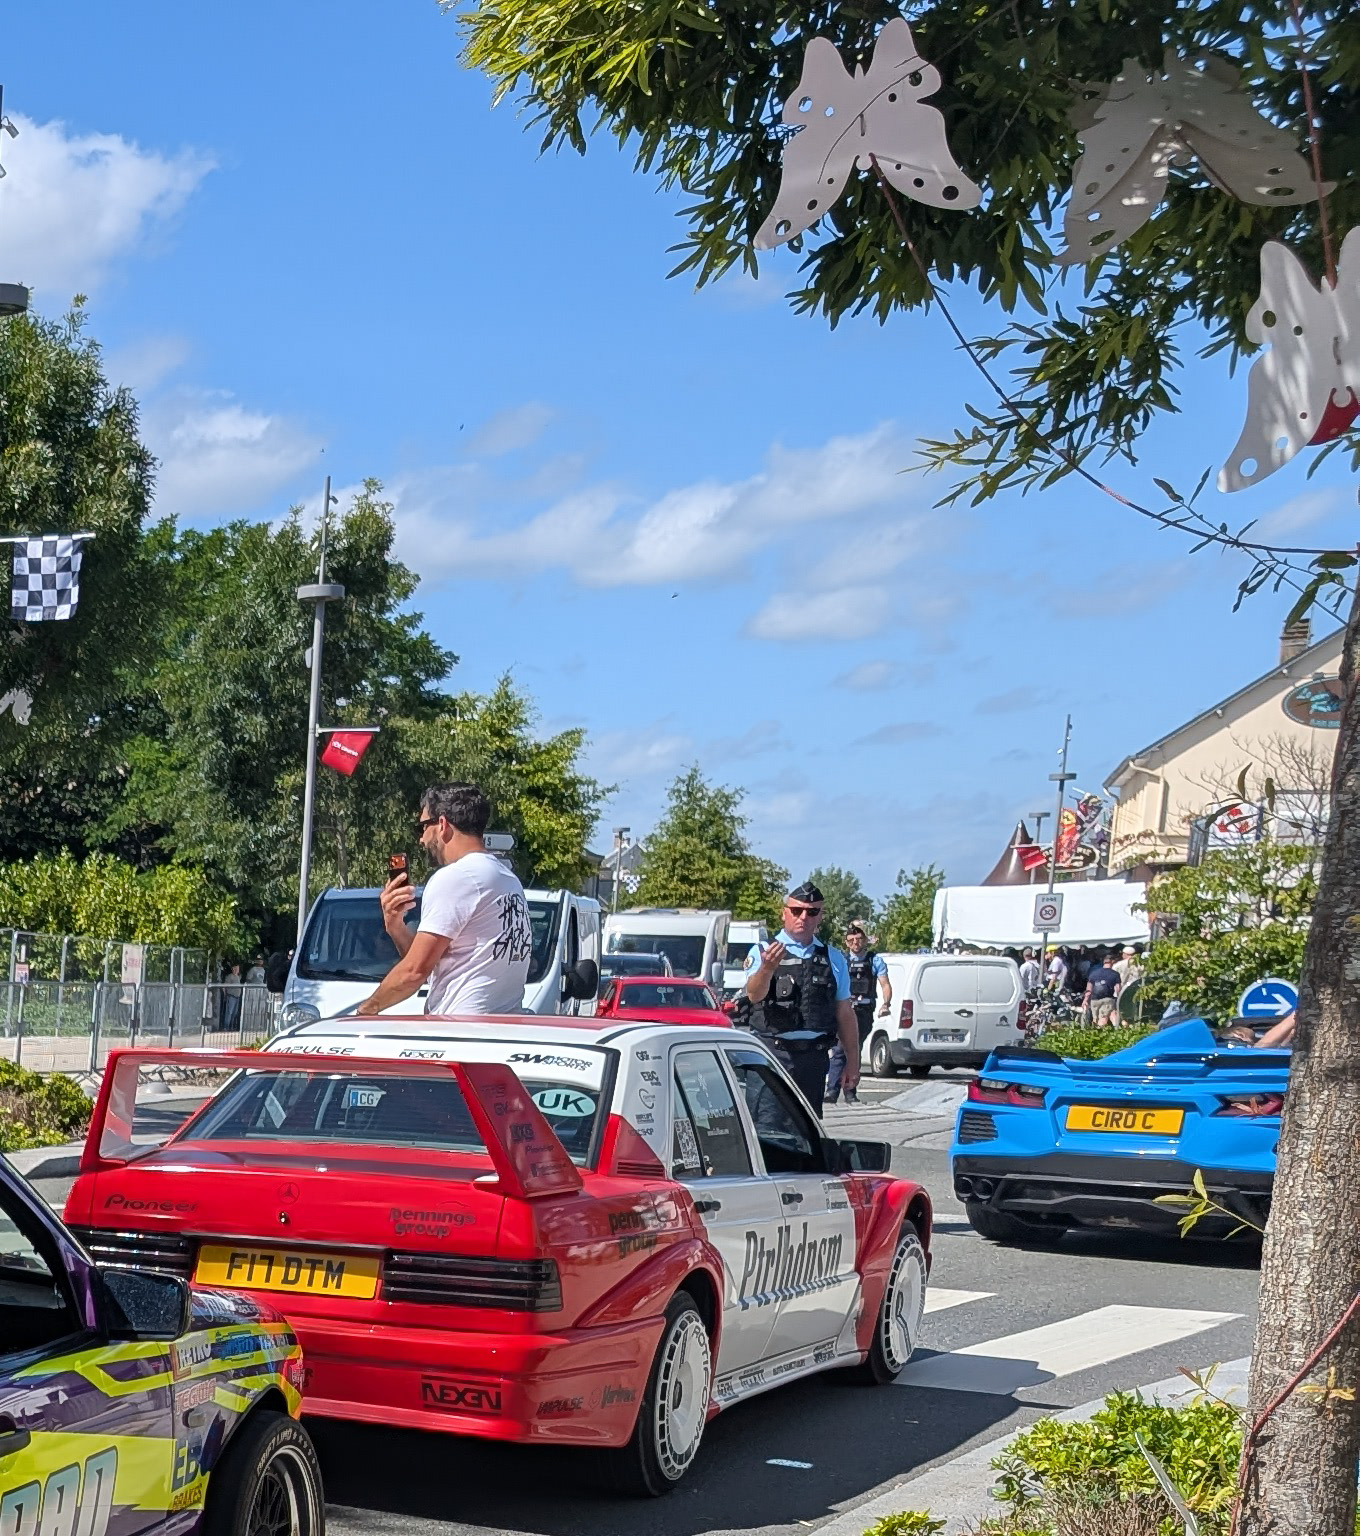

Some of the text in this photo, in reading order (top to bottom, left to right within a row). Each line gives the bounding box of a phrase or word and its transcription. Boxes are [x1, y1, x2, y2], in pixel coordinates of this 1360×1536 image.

[538, 1093, 588, 1114] UK
[1141, 1112, 1156, 1130] C
[103, 1193, 202, 1214] Pioneer
[389, 1207, 476, 1226] pennings
[394, 1222, 452, 1239] group
[226, 1251, 346, 1290] F17 DTM
